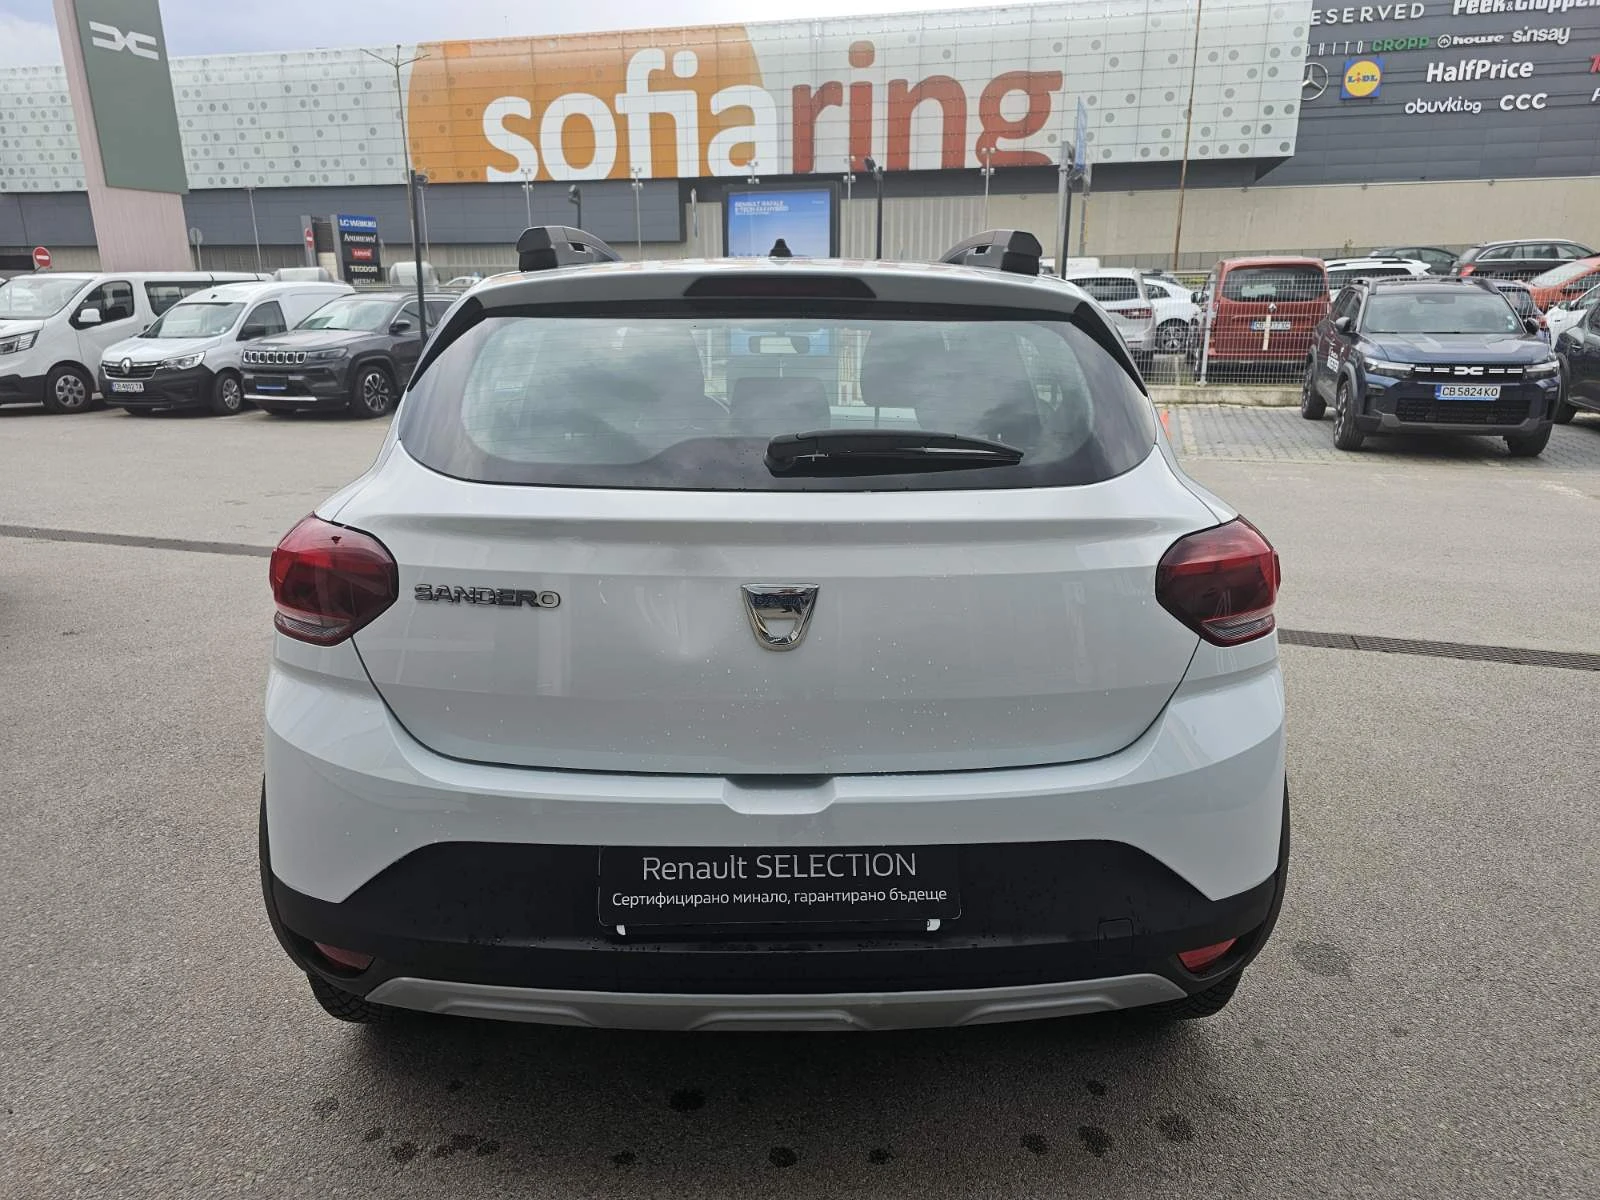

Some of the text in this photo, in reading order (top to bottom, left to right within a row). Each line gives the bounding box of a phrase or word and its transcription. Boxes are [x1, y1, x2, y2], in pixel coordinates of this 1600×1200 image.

[1372, 36, 1430, 52] CROPP
[1511, 26, 1570, 45] sinsay
[1426, 58, 1534, 83] HalfPrice
[1404, 96, 1482, 114] obuvki.bg
[1499, 92, 1548, 111] CCC
[1442, 387, 1456, 397] CB
[1457, 387, 1482, 397] 5824
[414, 583, 561, 608] SANDERO
[642, 852, 916, 880] Renault SELECTION
[612, 887, 948, 909] Сертифицирано минало, гарантирано бъдеще
